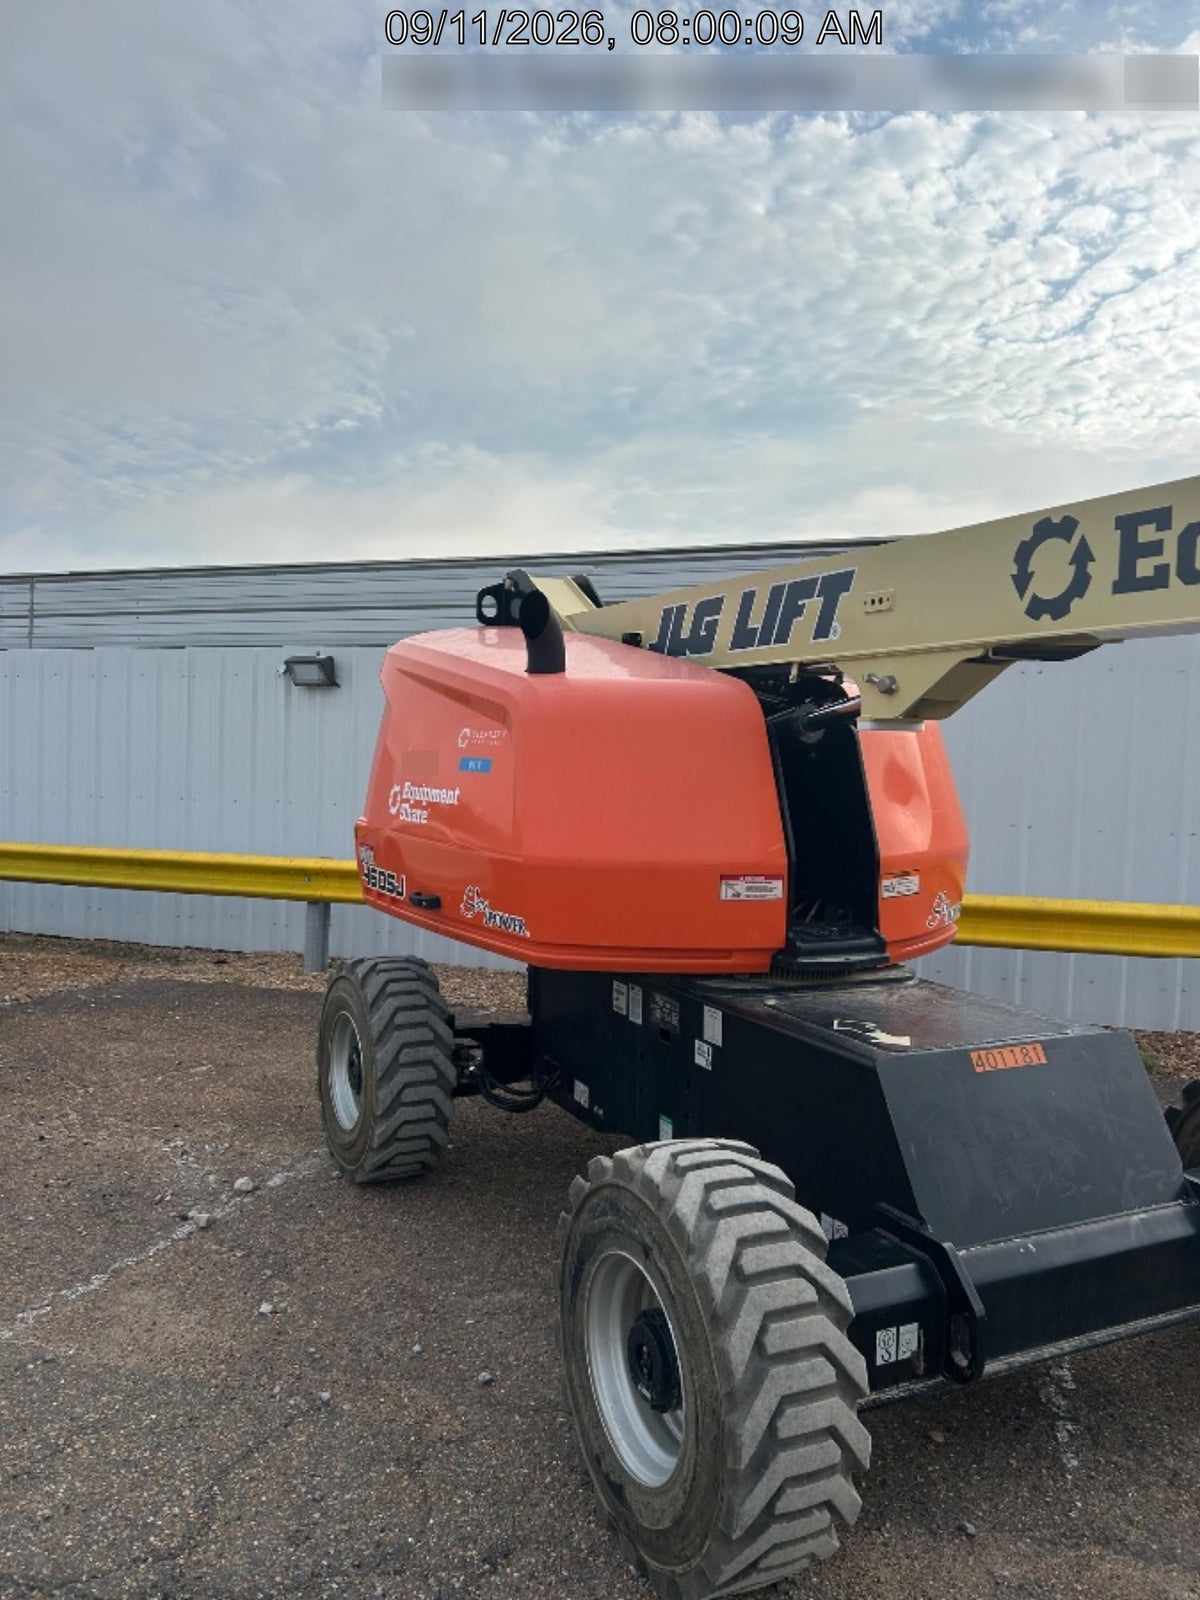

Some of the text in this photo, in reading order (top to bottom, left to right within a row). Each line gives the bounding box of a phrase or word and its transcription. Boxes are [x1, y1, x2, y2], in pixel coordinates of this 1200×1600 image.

[648, 567, 858, 658] JLG LIFT
[402, 781, 460, 806] Equipment
[399, 803, 429, 824] Share
[975, 1046, 1043, 1070] 401181
